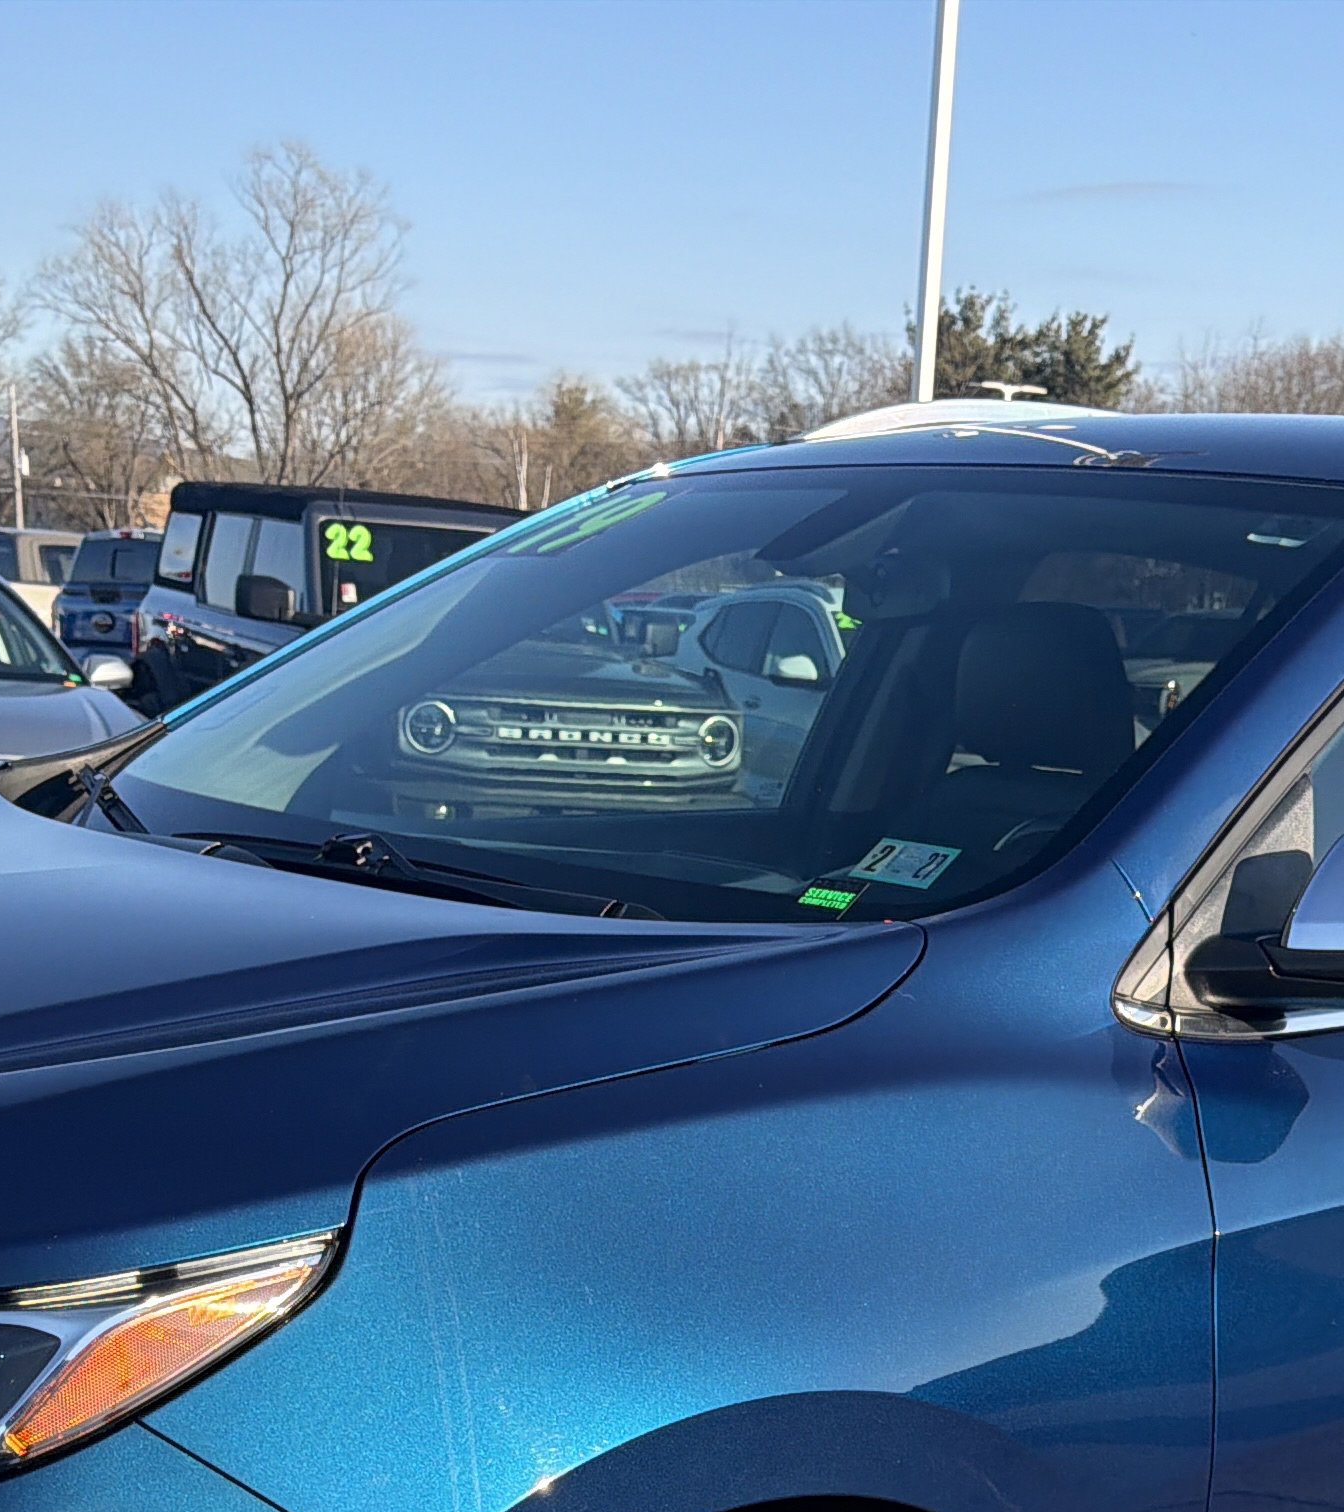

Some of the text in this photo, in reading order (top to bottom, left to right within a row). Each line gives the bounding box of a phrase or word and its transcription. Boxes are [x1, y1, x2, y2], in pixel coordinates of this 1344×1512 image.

[324, 523, 374, 562] 22
[498, 727, 670, 745] BRONCO
[912, 852, 950, 880] 27
[805, 887, 857, 902] SERVICE
